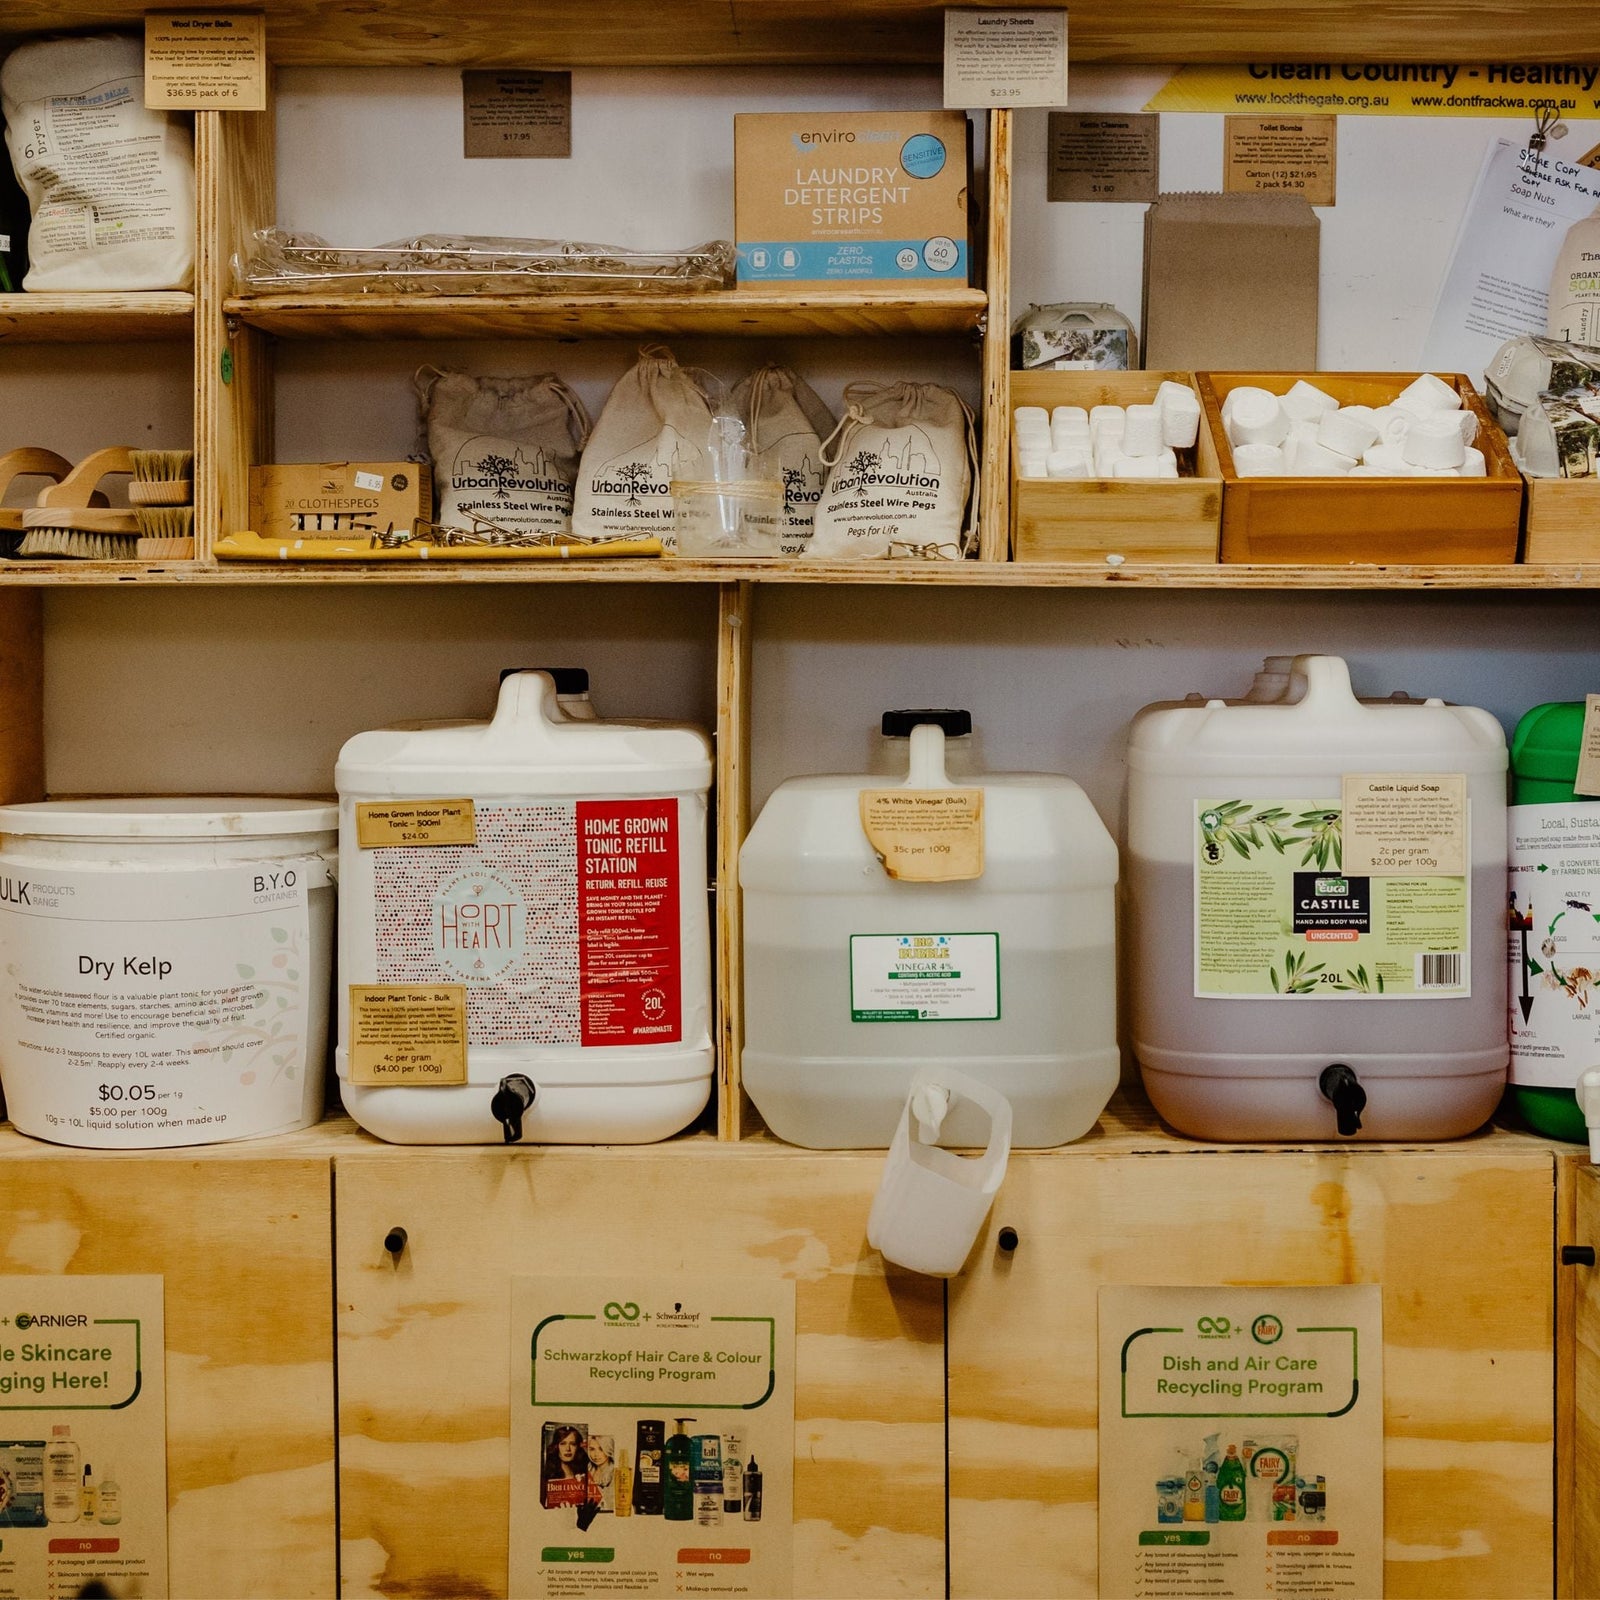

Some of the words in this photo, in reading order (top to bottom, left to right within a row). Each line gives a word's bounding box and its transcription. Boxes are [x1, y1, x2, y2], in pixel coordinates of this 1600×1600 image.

[193, 21, 213, 29] Dryer
[978, 18, 1007, 26] Laundry
[1249, 64, 1331, 80] Clean
[1342, 64, 1459, 88] Country
[1488, 64, 1598, 91] Healthy
[167, 89, 197, 97] $36.95
[200, 89, 219, 98] pack
[222, 89, 230, 97] of
[232, 89, 238, 97] 6
[990, 89, 1021, 97] $23.95
[1235, 92, 1389, 108] www.lockthegate.org.au
[1411, 94, 1576, 109] www.dontfrackwa.com.au
[903, 147, 943, 163] SENSITIVE
[797, 168, 898, 185] LAUNDRY
[1272, 171, 1288, 179] (12)
[784, 187, 911, 206] DETERGENT
[1510, 184, 1532, 198] Soap
[1534, 192, 1556, 205] Nuts
[812, 208, 883, 225] STRIPS
[1503, 206, 1521, 217] What
[1522, 214, 1534, 222] are
[1535, 217, 1555, 228] they?
[836, 246, 864, 256] ZERO
[933, 247, 948, 258] 60
[828, 256, 873, 265] PLASTICS
[901, 254, 913, 263] 60
[452, 477, 572, 494] UrbanRevolution
[831, 473, 939, 493] UrbanRevolution
[906, 490, 938, 498] Australia
[298, 498, 379, 509] CLOTHESPEGS
[457, 500, 501, 512] Stainless
[504, 501, 528, 511] Steel
[530, 503, 553, 511] Wire
[555, 505, 573, 517] Pegs
[827, 500, 858, 513] Stainless
[860, 498, 884, 508] Steel
[887, 499, 910, 507] Wire
[912, 501, 936, 510] Pegs
[847, 527, 866, 537] Pegs
[867, 526, 880, 536] for
[882, 525, 899, 534] Life
[1396, 784, 1418, 793] Liquid
[1421, 785, 1440, 793] Soap
[915, 798, 944, 806] Vinegar
[945, 797, 967, 805] (Bulk)
[388, 820, 408, 828] Tonic
[417, 819, 441, 827] 500ml
[585, 819, 620, 835] HOME
[624, 817, 668, 834] GROWN
[1542, 818, 1568, 830] Local,
[585, 838, 622, 854] TONIC
[626, 837, 667, 853] REFILL
[893, 845, 909, 853] 35c
[929, 845, 950, 853] 100g
[1392, 848, 1405, 856] per
[1408, 848, 1429, 856] gram
[586, 857, 637, 874] STATION
[1371, 858, 1396, 866] $2.00
[1399, 859, 1412, 867] per
[1416, 858, 1437, 867] 100g
[253, 870, 296, 893] B.Y.O
[32, 884, 75, 895] PRODUCTS
[33, 897, 59, 907] RANGE
[253, 890, 298, 905] CONTAINER
[1301, 900, 1360, 909] CASTILE
[898, 948, 950, 959] BUBBLE
[78, 955, 114, 981] Dry
[123, 955, 172, 980] Kelp
[895, 963, 937, 971] VINEGAR
[1320, 974, 1343, 983] 20L
[160, 992, 178, 1001] plant
[645, 997, 663, 1010] 20L
[373, 1065, 399, 1074] ($4.00
[402, 1066, 415, 1074] per
[419, 1065, 442, 1073] 100g)
[98, 1083, 156, 1102] $0.05
[173, 1091, 183, 1099] 1g
[89, 1107, 118, 1117] $5.00
[120, 1109, 137, 1118] per
[142, 1108, 167, 1118] 100g
[45, 1114, 58, 1126] 10g
[69, 1118, 84, 1128] 10L
[86, 1119, 112, 1131] liquid
[115, 1120, 154, 1129] solution
[157, 1120, 183, 1128] when
[187, 1115, 212, 1126] made
[215, 1114, 227, 1123] up
[16, 1315, 88, 1328] GARNIER
[656, 1312, 700, 1322] Schwarzkopf
[1257, 1325, 1277, 1336] FAIRY
[22, 1344, 112, 1362] Skincare
[543, 1350, 632, 1364] Schwarzkopf
[635, 1351, 664, 1362] Hair
[666, 1351, 700, 1363] Care
[702, 1352, 713, 1363] &
[716, 1351, 762, 1364] Colour
[1162, 1356, 1201, 1371] Dish
[1206, 1356, 1238, 1371] and
[1244, 1356, 1270, 1370] Air
[1274, 1356, 1318, 1370] Care
[589, 1366, 655, 1382] Recycling
[658, 1368, 716, 1382] Program
[0, 1372, 46, 1394] ging
[52, 1372, 109, 1388] Here!
[1157, 1379, 1242, 1398] Recycling
[1248, 1379, 1323, 1397] Program
[1260, 1457, 1280, 1468] FAIRY
[1164, 1535, 1181, 1543] yes
[568, 1551, 585, 1560] yes
[708, 1552, 722, 1560] no
